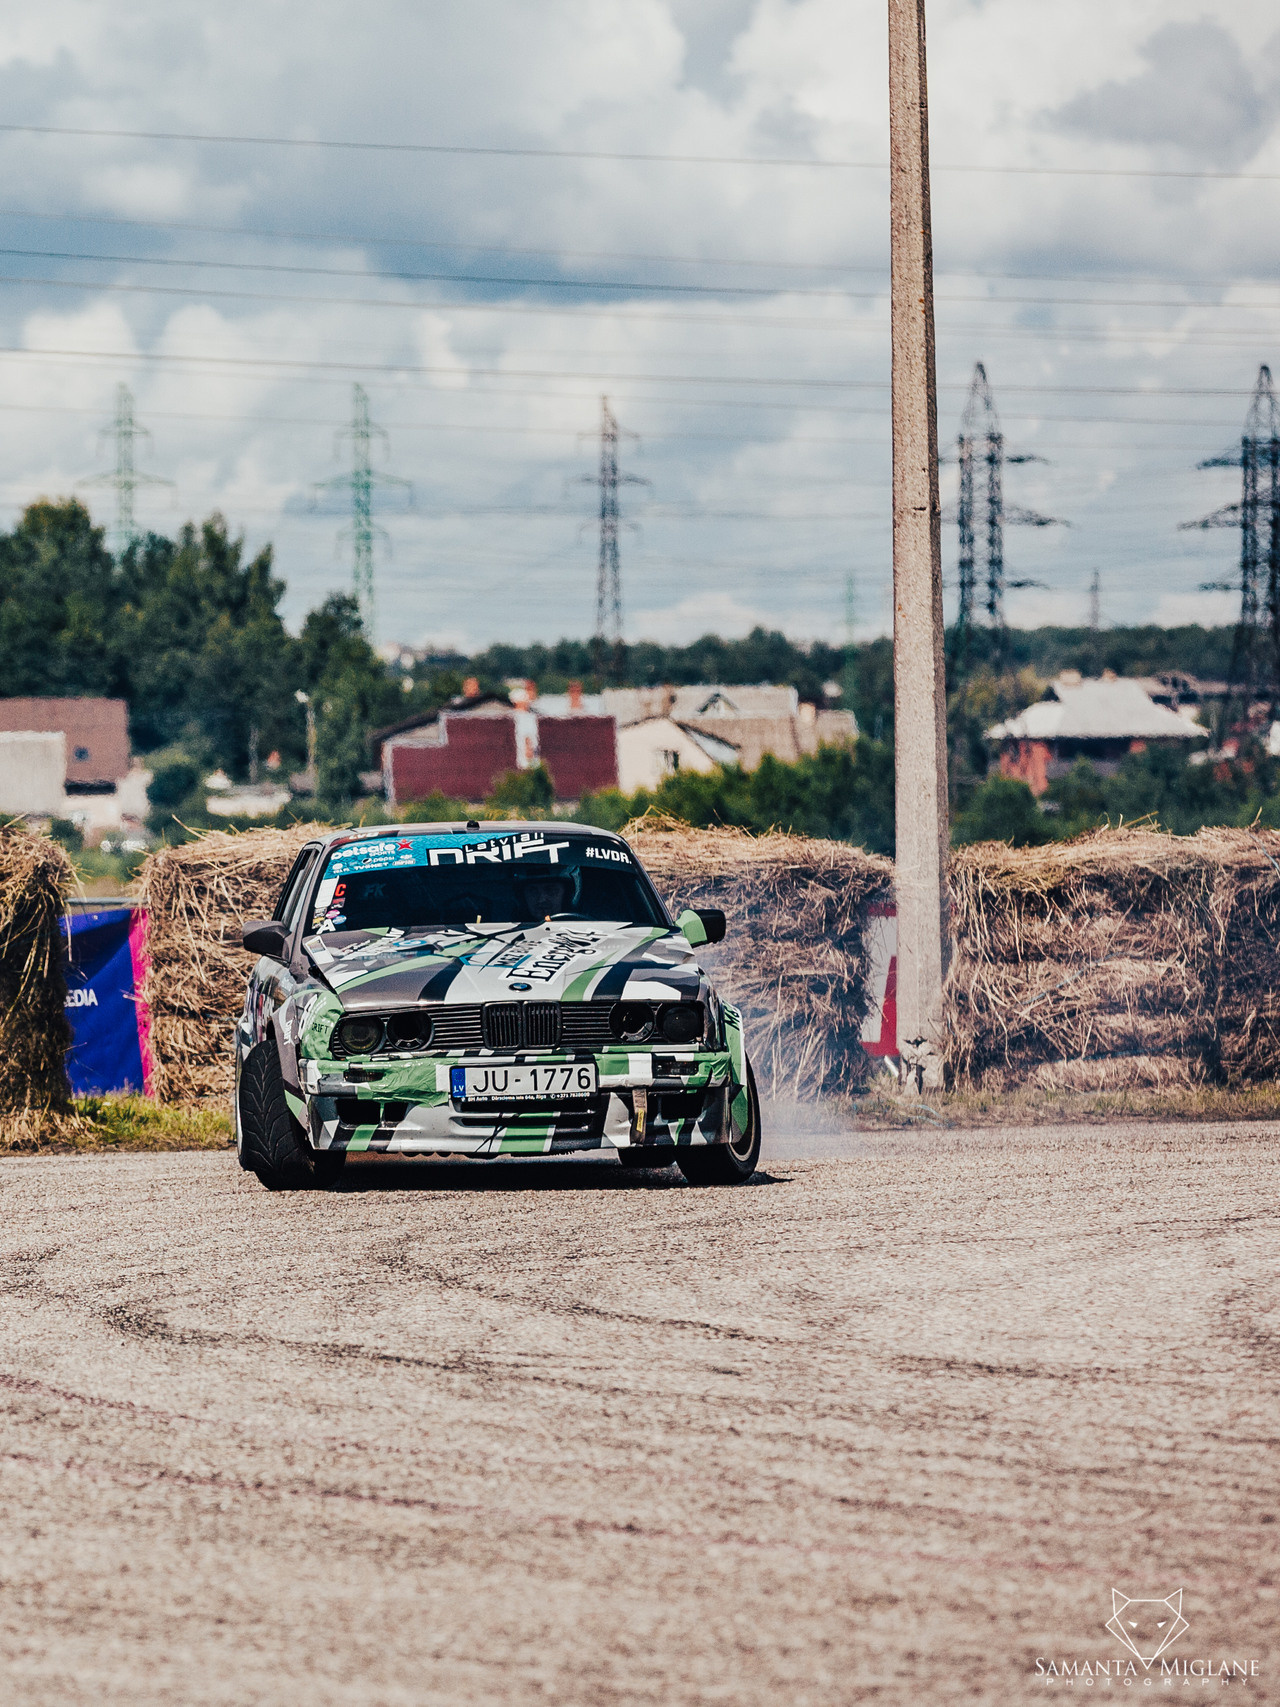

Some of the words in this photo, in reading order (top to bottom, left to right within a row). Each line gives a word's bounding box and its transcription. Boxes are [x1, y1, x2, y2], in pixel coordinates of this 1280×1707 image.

[429, 839, 570, 866] DRIFT
[453, 1085, 464, 1093] LV
[473, 1068, 591, 1092] JU-1776
